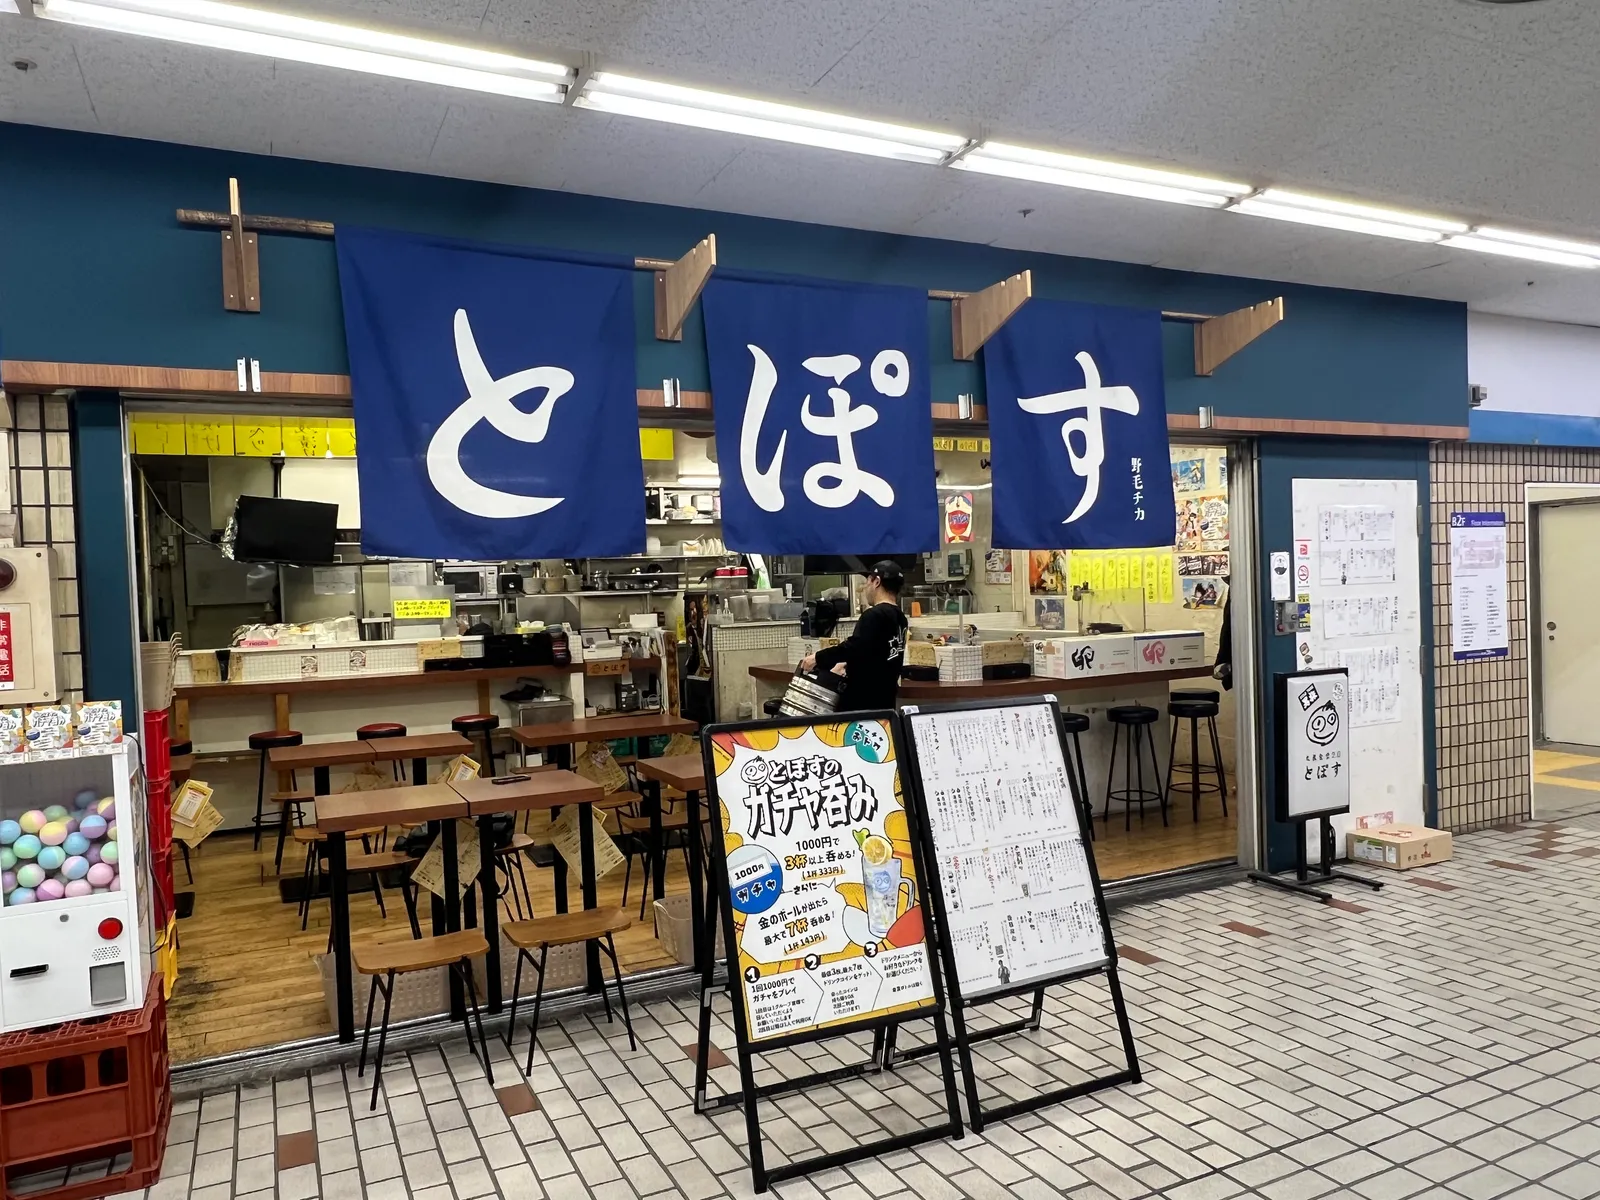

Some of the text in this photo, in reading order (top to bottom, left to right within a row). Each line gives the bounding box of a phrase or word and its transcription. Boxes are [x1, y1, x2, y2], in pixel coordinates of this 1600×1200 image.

[1131, 457, 1145, 521] 野毛チカ
[1451, 514, 1466, 527] B2F
[1071, 645, 1095, 670] 卵
[1142, 640, 1166, 665] 卵
[852, 731, 881, 751] おトク
[769, 754, 842, 783] とぽすの
[1304, 761, 1342, 781] とぽす
[743, 773, 879, 840] ガチャ呑み
[795, 836, 840, 852] 1000円で
[734, 863, 765, 881] 1000円
[736, 878, 777, 903] ガチャ
[792, 881, 818, 896] さらに
[757, 896, 829, 930] 金のボールが出たら
[751, 976, 795, 993] 1回1000円で
[752, 986, 798, 1003] ガチャをプレイ
